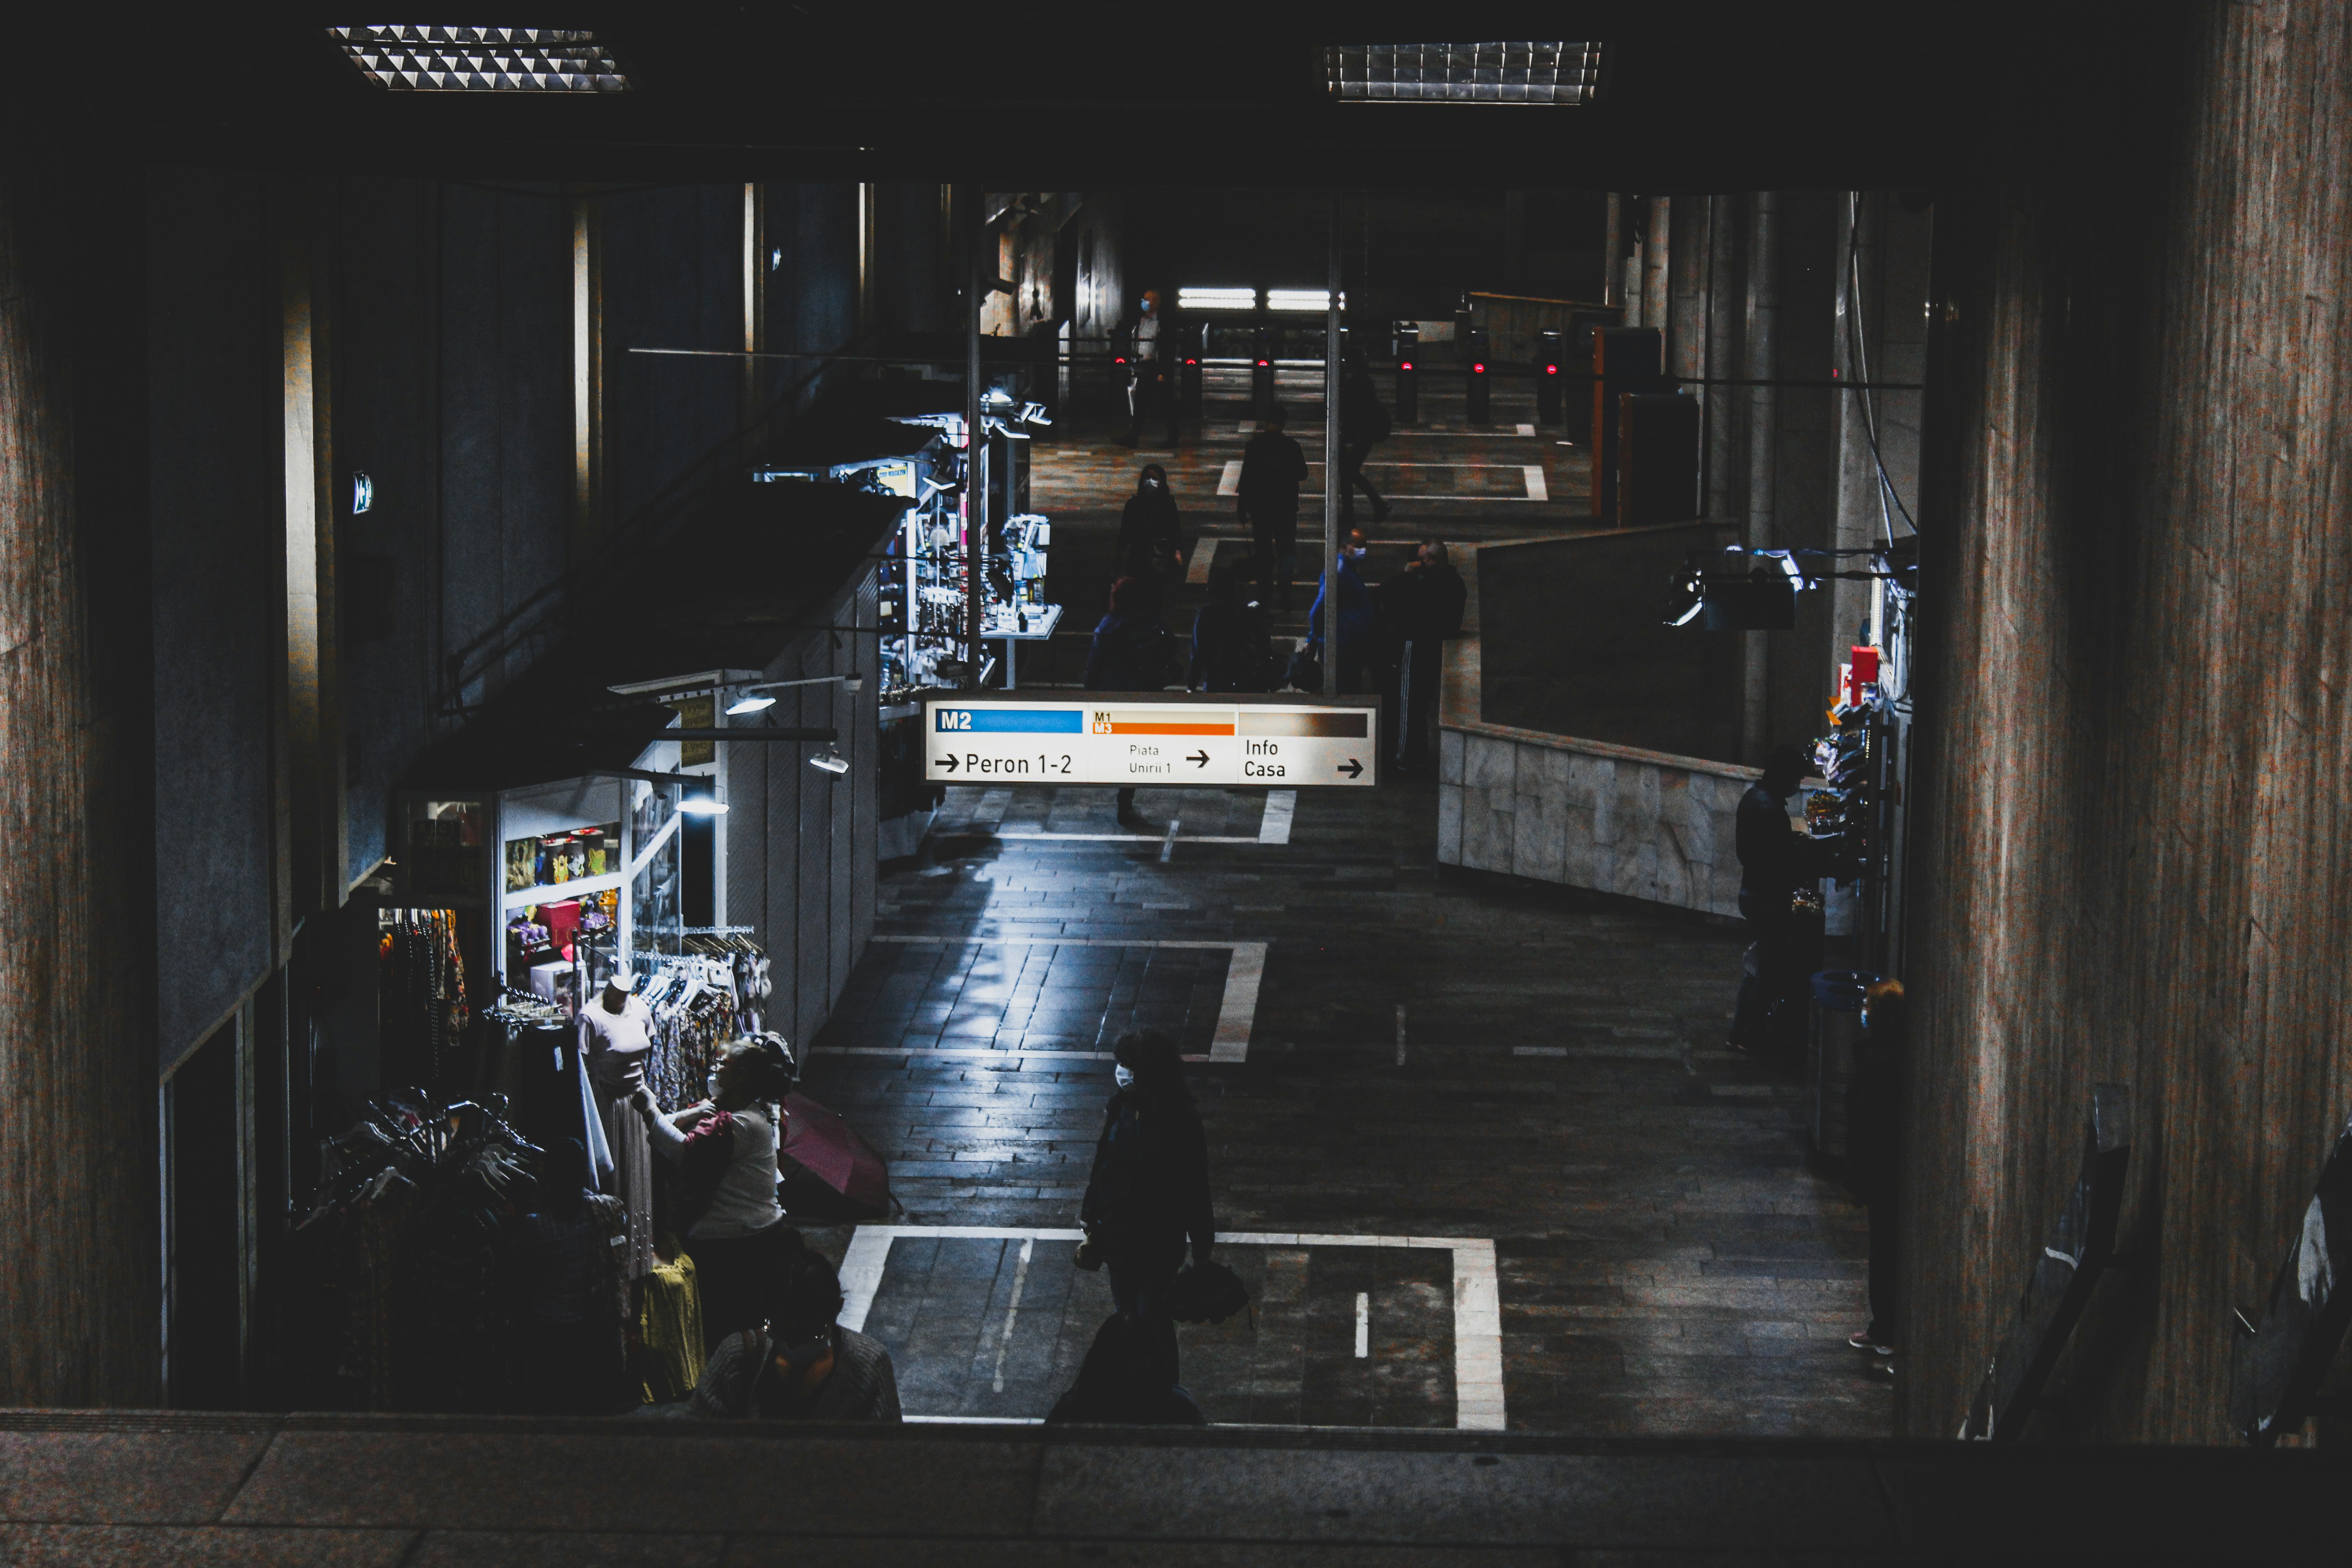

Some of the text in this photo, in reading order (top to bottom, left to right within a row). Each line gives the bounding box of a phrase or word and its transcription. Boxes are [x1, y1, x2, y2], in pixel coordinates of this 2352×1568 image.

[941, 711, 972, 730] M2
[1095, 712, 1111, 722] M1
[1094, 723, 1112, 734] M3
[1130, 745, 1159, 755] Piata
[1247, 740, 1278, 755] Info
[966, 754, 1071, 774] Peron 1-2
[1130, 762, 1171, 774] Unirii 1
[1245, 761, 1285, 777] Casa
